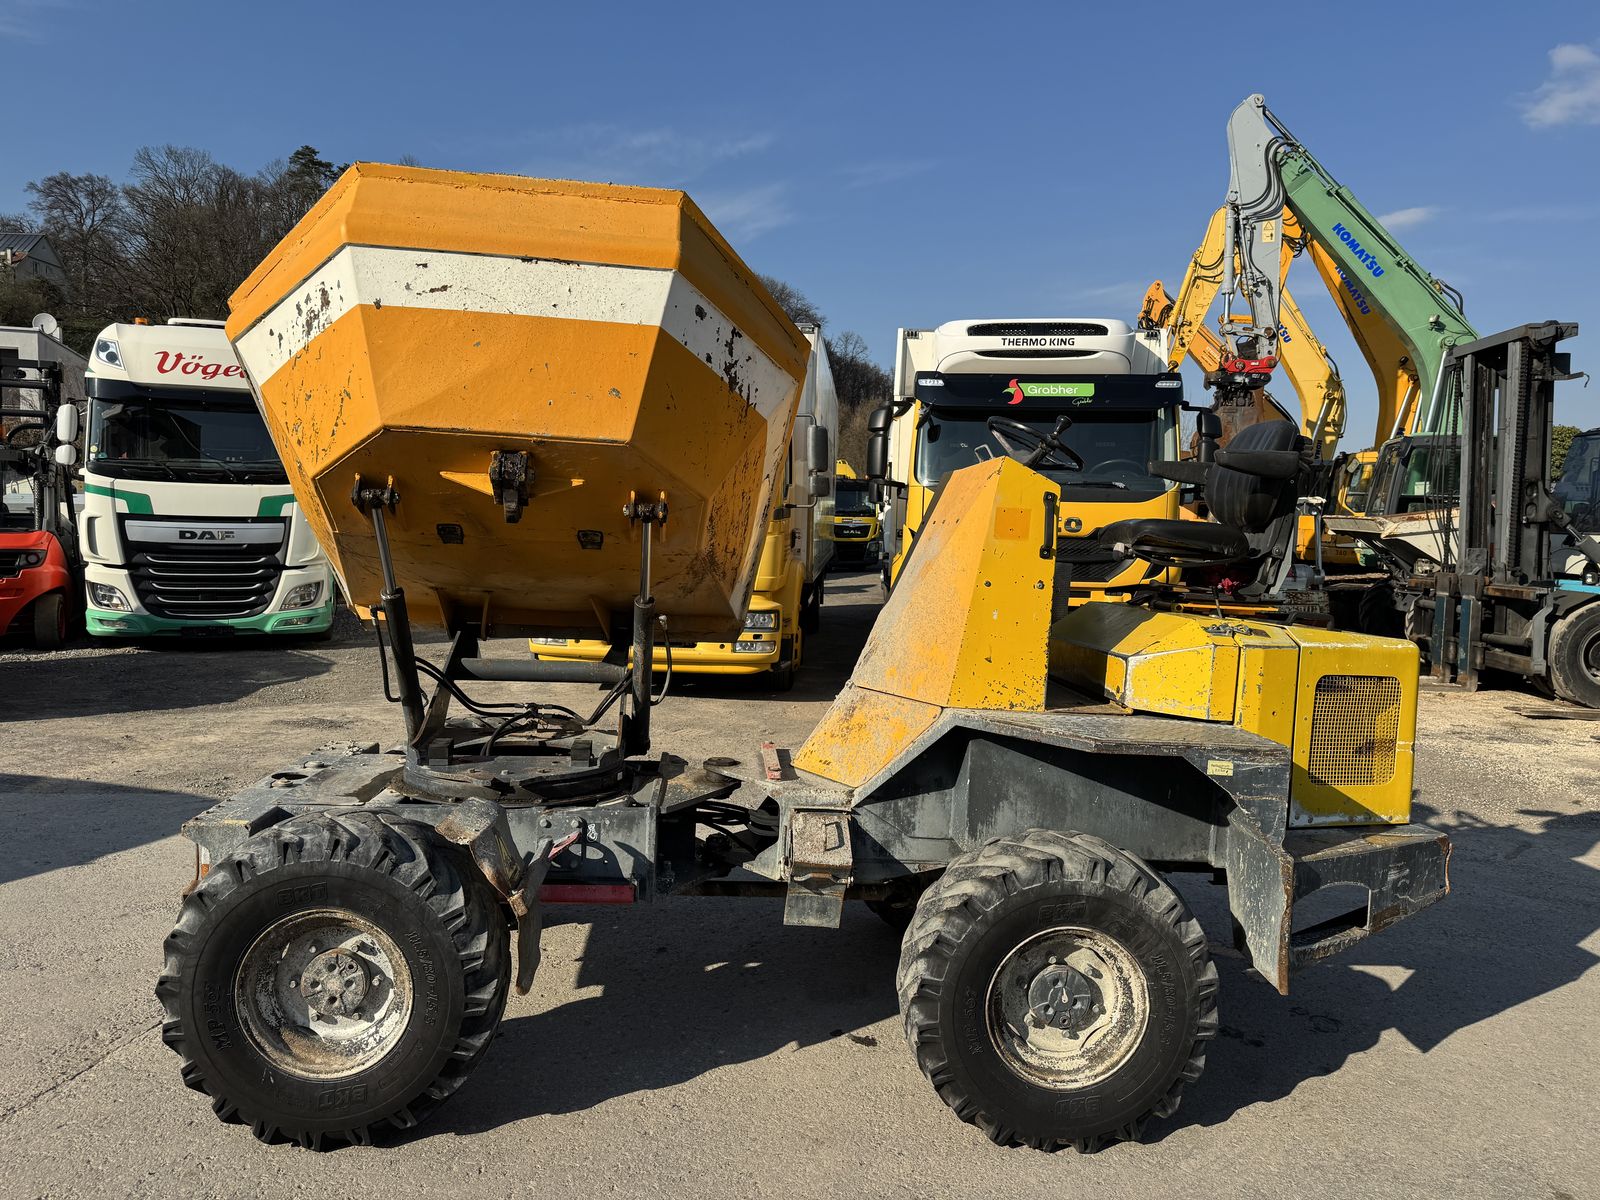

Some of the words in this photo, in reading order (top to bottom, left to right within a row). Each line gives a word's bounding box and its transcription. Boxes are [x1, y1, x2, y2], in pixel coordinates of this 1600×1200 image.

[1332, 222, 1385, 278] KOMATSU
[1001, 337, 1047, 347] THERMO
[1048, 337, 1076, 347] KING
[1027, 384, 1079, 396] Grabher
[178, 530, 236, 541] DAF
[207, 1018, 233, 1051] MP
